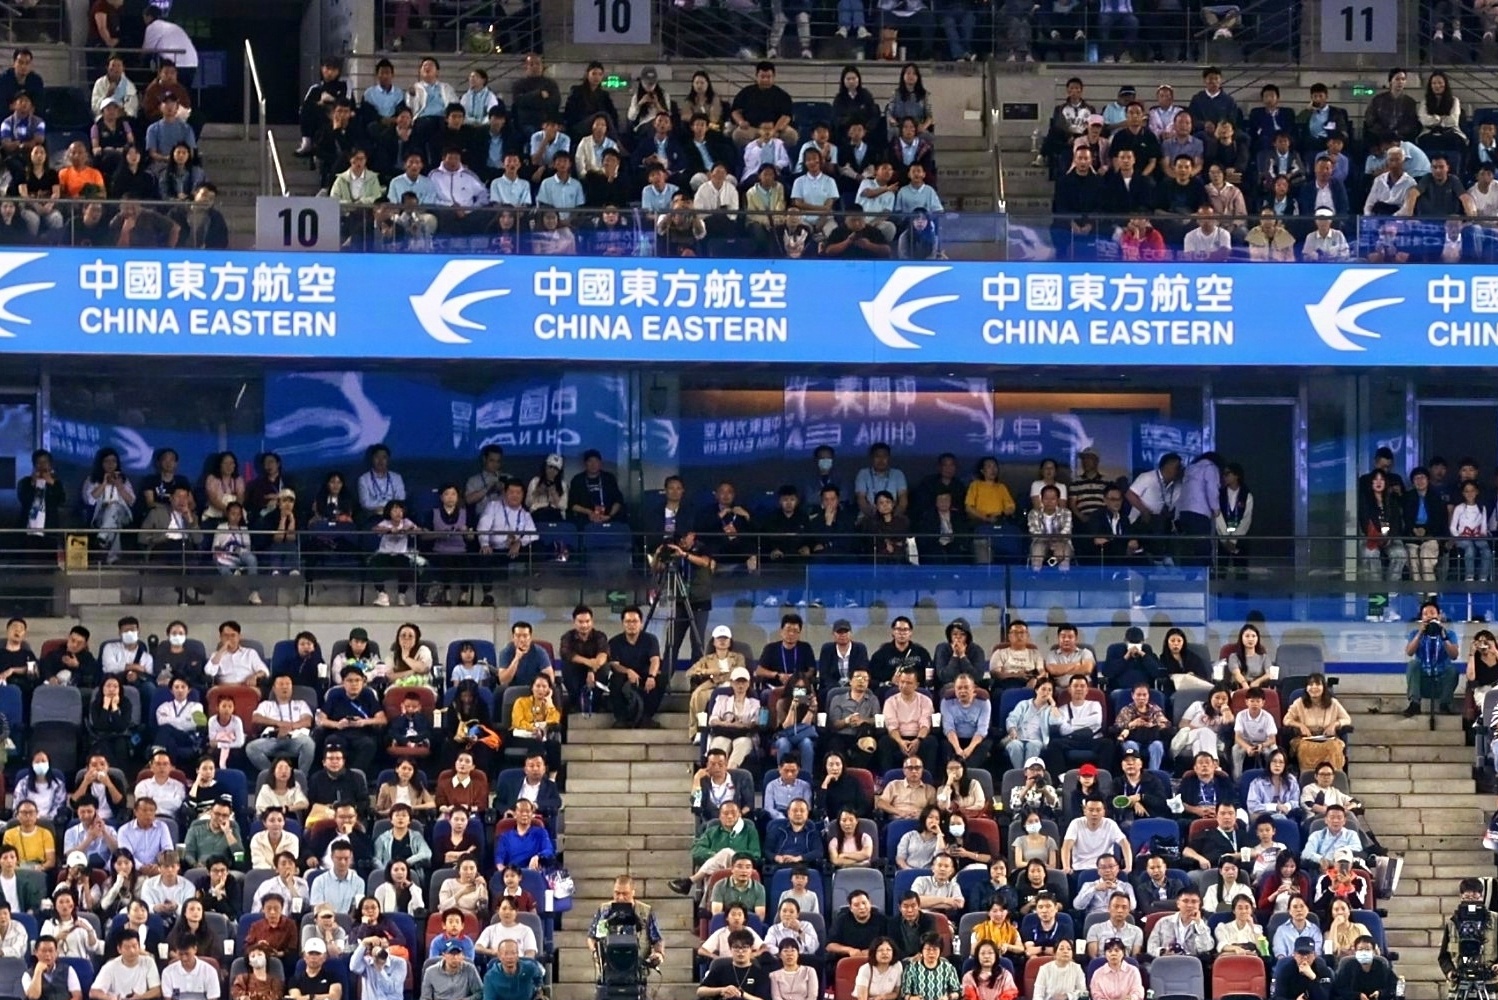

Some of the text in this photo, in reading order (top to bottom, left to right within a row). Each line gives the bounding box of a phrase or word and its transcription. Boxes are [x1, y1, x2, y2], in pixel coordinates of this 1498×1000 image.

[593, 0, 631, 34] 10
[1340, 6, 1373, 42] 11
[278, 208, 319, 247] 10
[80, 260, 336, 303] 中國東方航空
[535, 266, 787, 309] 中國東方航空
[982, 272, 1234, 313] 中國東方航空
[80, 308, 336, 337] CHINA EASTERN
[534, 313, 788, 342] CHINA EASTERN
[982, 320, 1234, 346] CHINA EASTERN
